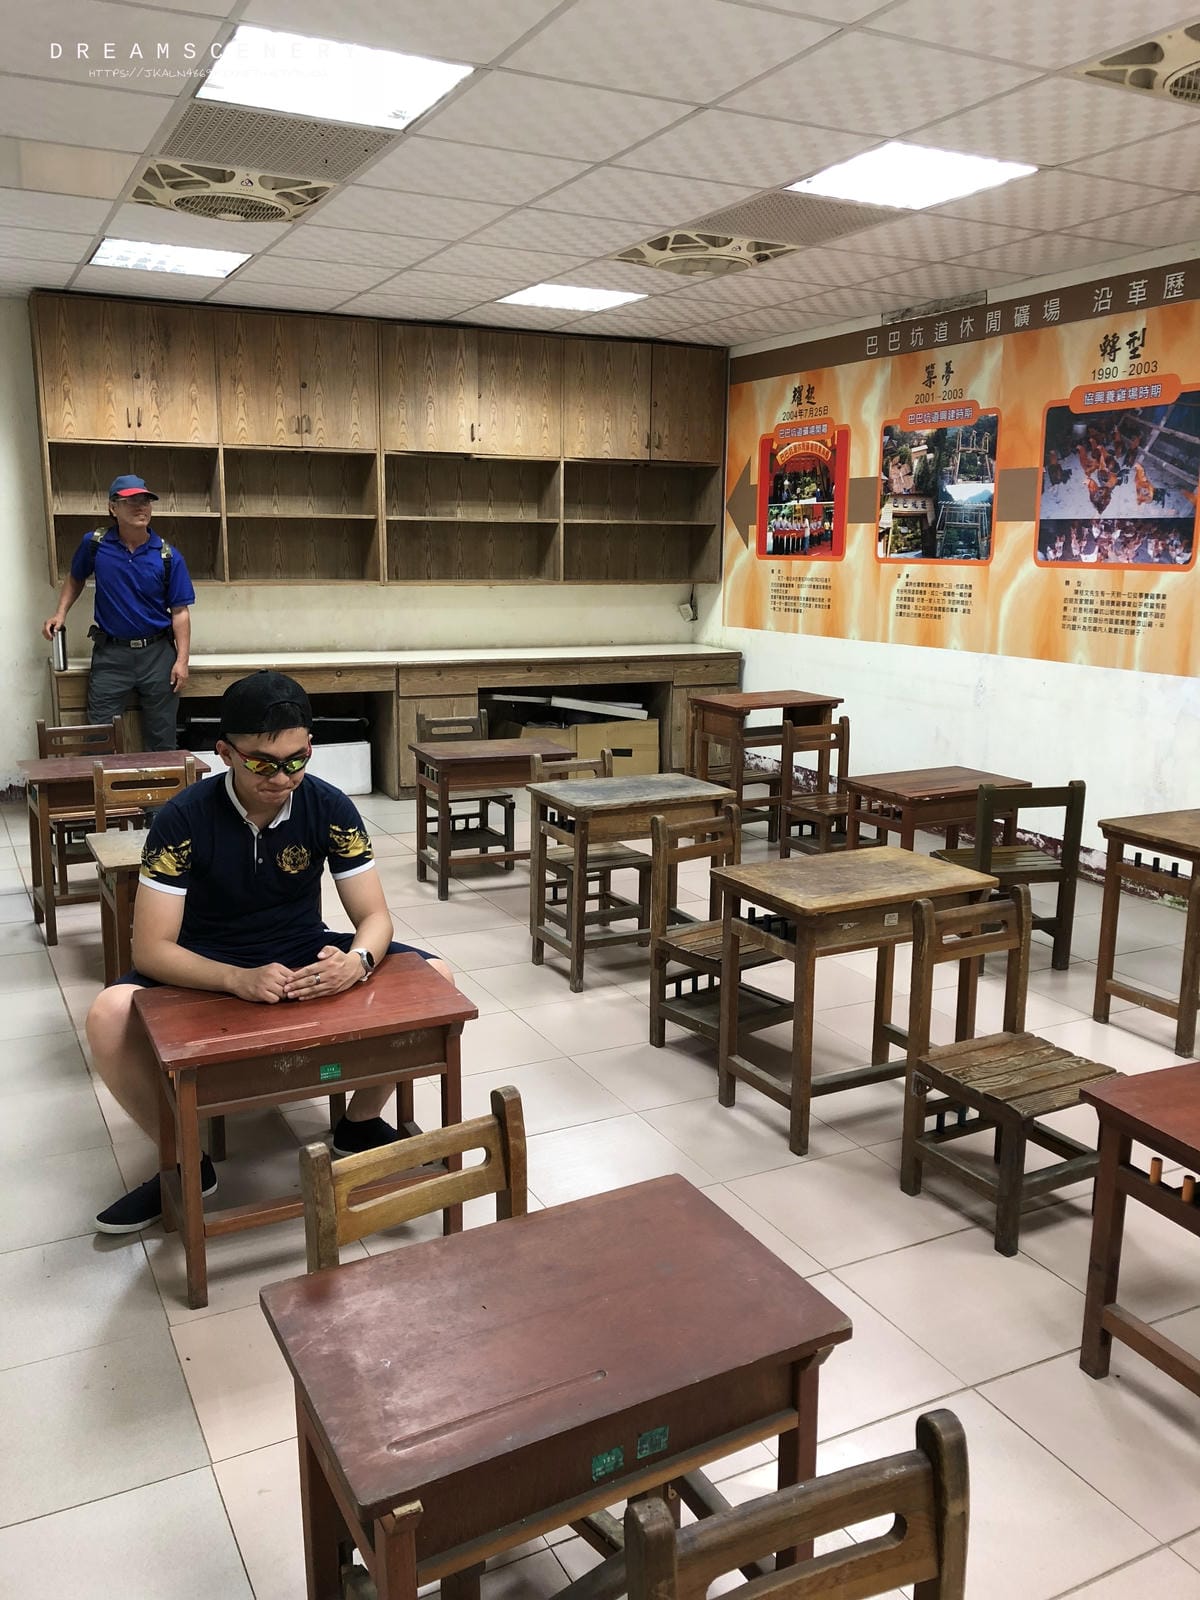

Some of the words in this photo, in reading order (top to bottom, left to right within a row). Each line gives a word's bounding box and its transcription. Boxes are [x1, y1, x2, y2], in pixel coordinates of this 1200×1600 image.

[866, 298, 1061, 355] 巴巴坑道休閒礦場
[1092, 271, 1185, 313] 沿革歷
